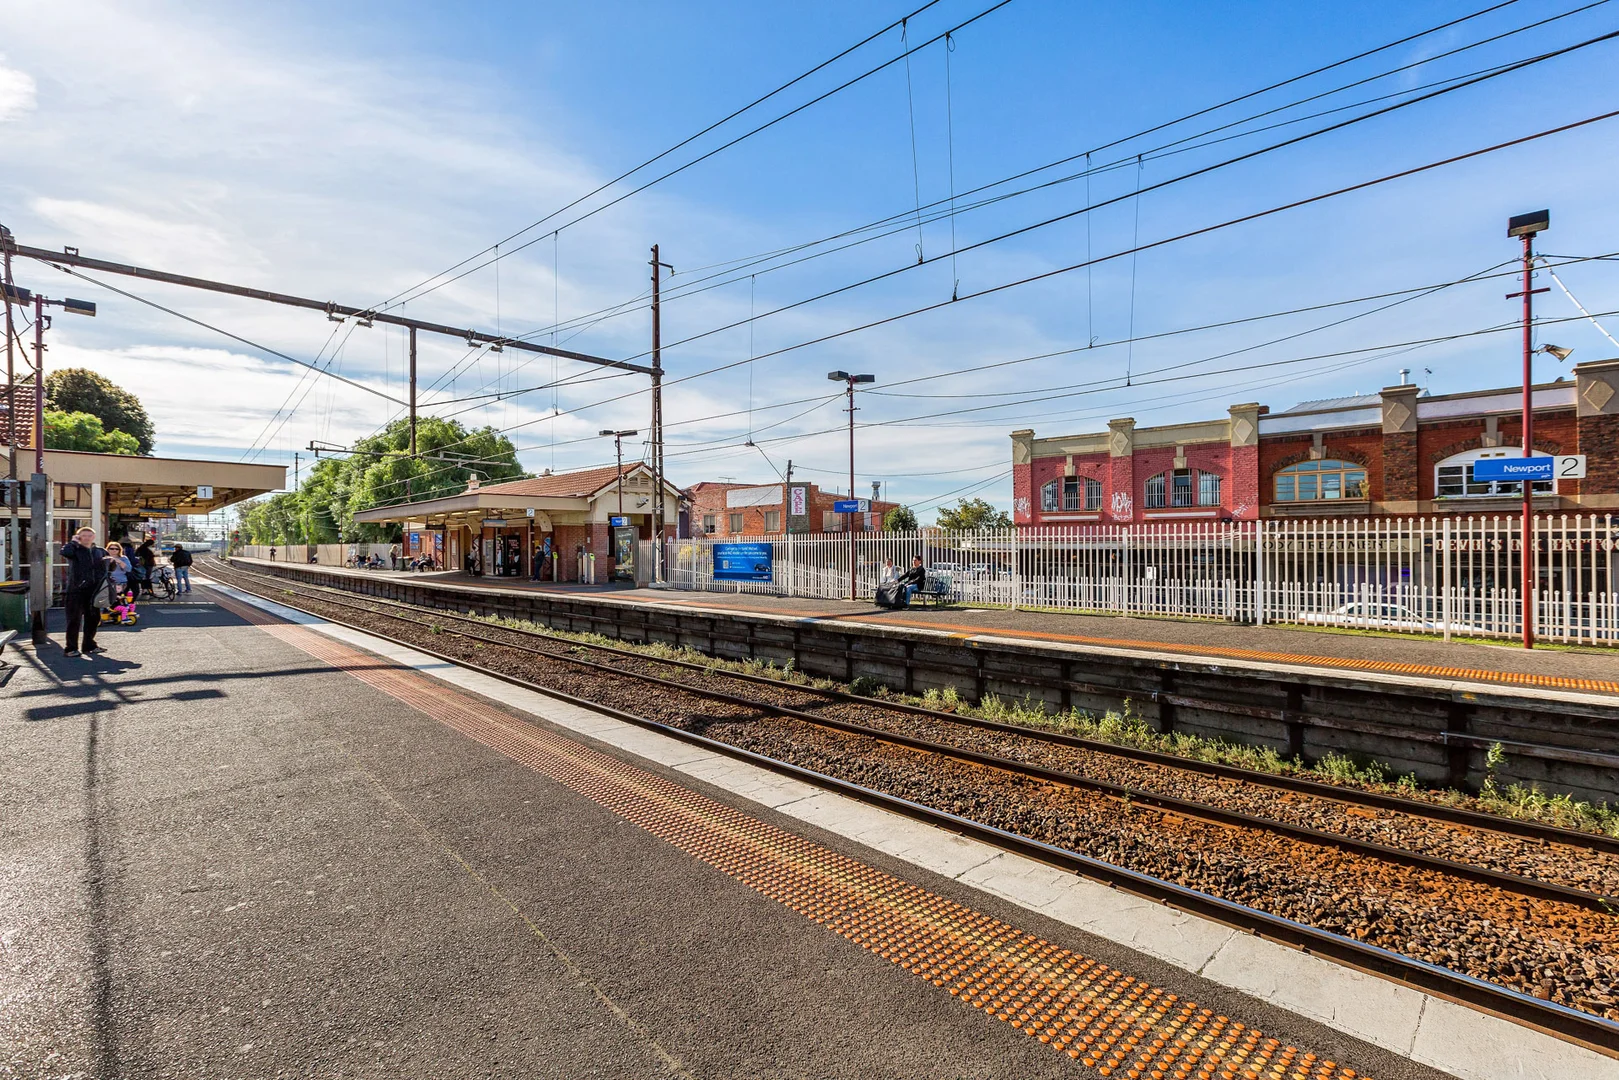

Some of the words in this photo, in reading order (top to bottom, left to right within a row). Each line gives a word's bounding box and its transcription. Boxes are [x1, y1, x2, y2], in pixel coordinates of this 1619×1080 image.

[1503, 464, 1551, 473] Newport
[1561, 457, 1578, 476] 2
[201, 488, 206, 497] 1
[793, 489, 803, 513] CAFE
[860, 501, 866, 510] 2
[1253, 541, 1292, 550] ODY
